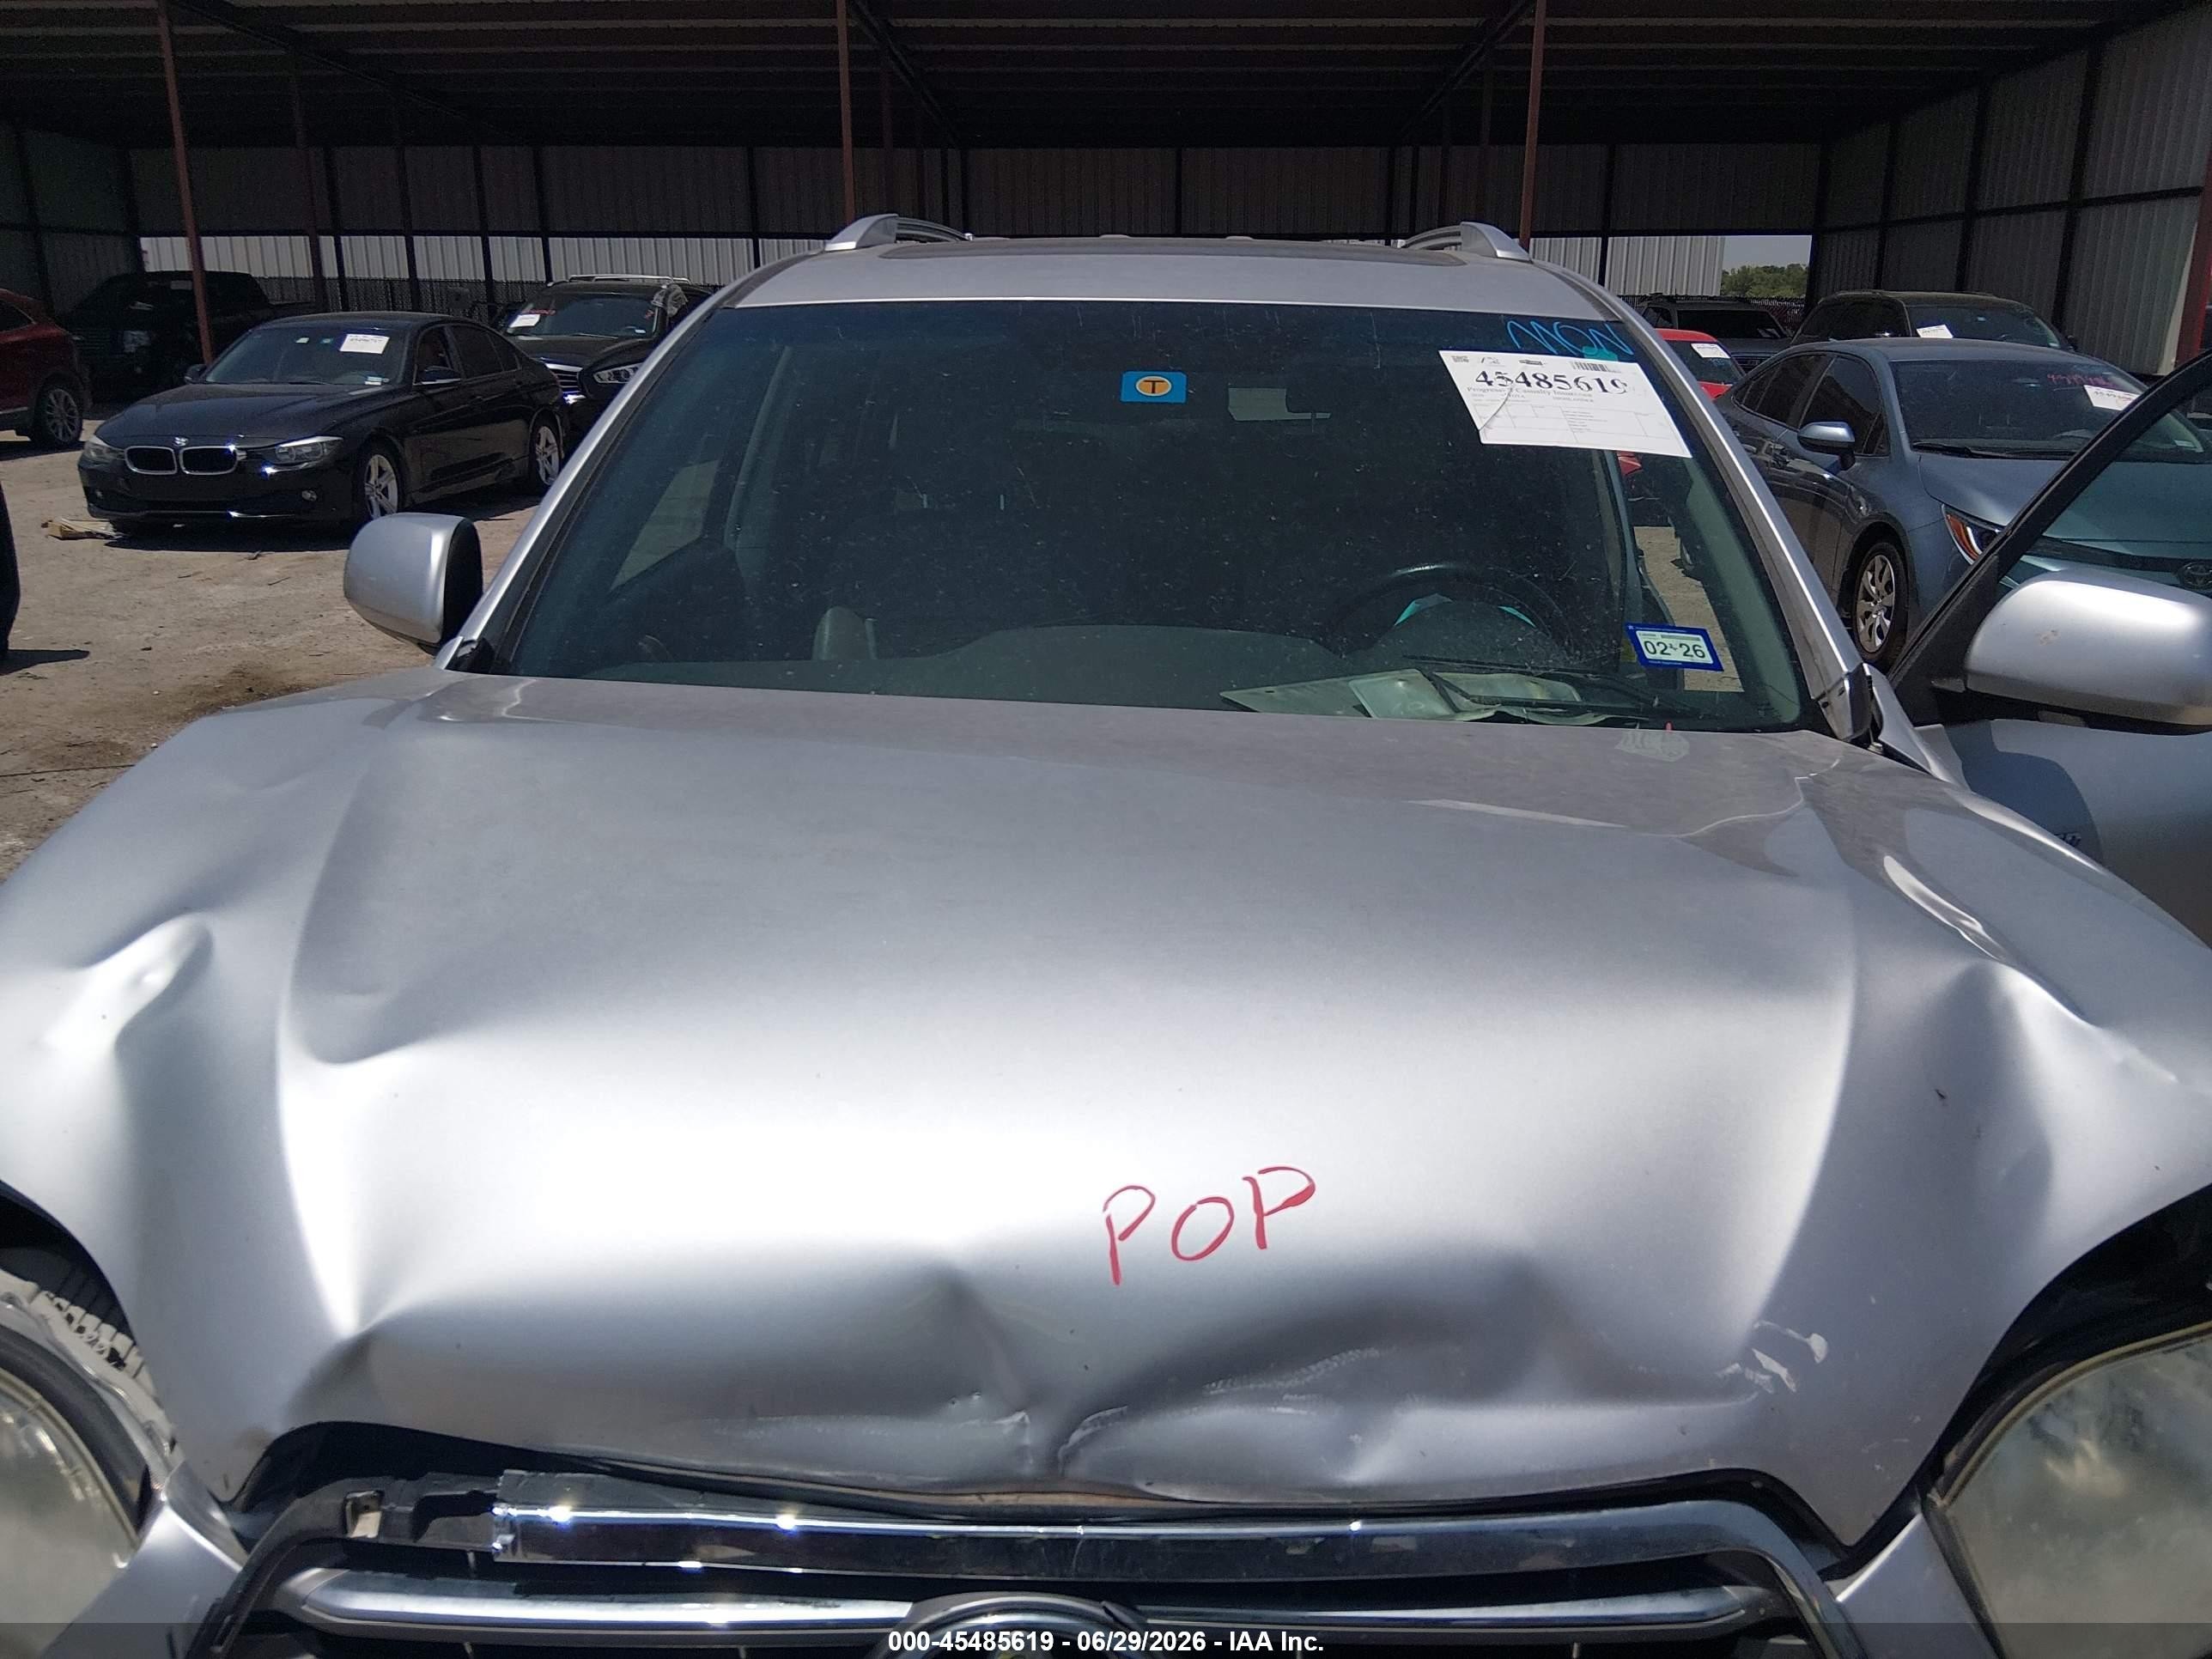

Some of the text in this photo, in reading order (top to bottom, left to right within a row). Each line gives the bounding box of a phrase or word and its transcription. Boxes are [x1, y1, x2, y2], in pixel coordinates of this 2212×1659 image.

[1143, 380, 1165, 394] T
[1475, 370, 1628, 395] 45485619
[1644, 640, 1706, 659] 02 26
[1103, 1165, 1316, 1286] POP
